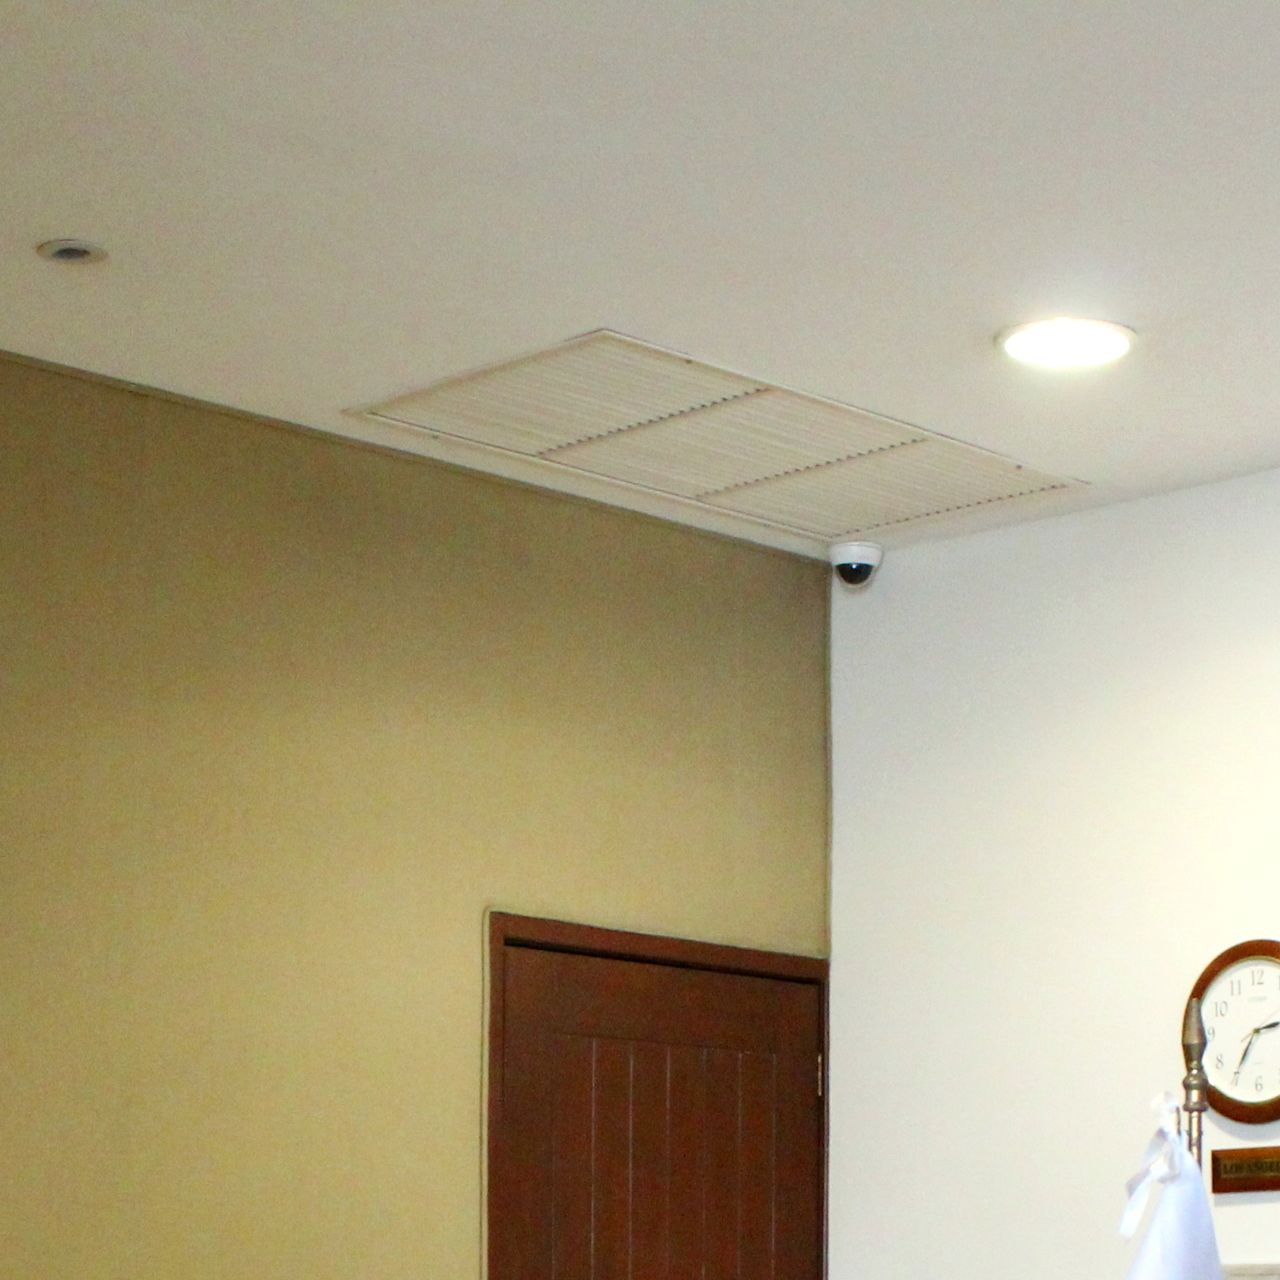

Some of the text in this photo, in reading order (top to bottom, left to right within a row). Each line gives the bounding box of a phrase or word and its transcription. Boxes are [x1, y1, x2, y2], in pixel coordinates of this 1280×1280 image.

[1251, 969, 1265, 986] 12
[1230, 980, 1242, 996] 11
[1215, 1001, 1228, 1017] 10
[1215, 1053, 1224, 1070] 8
[1255, 1075, 1263, 1092] 6
